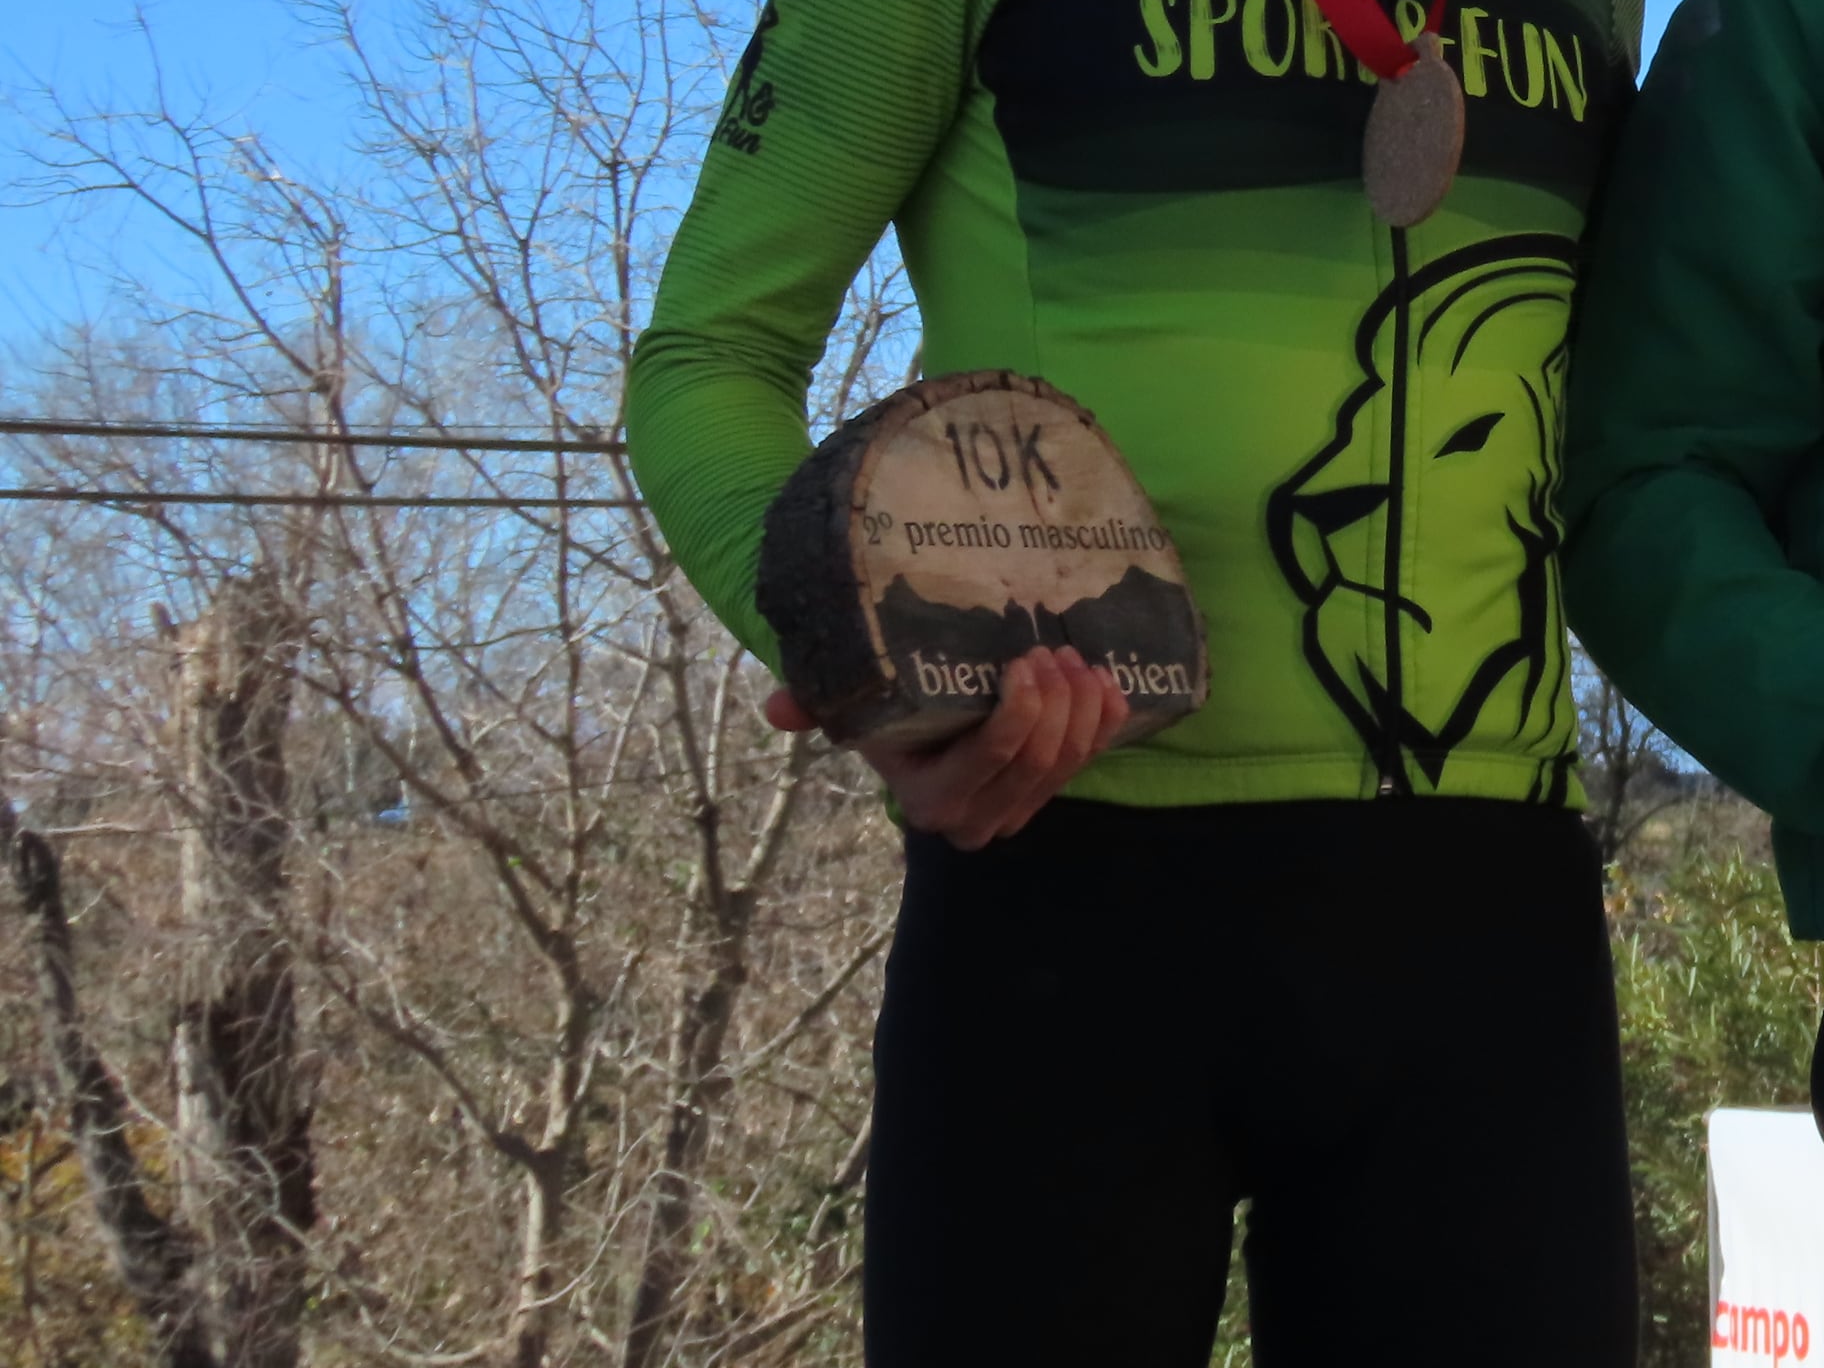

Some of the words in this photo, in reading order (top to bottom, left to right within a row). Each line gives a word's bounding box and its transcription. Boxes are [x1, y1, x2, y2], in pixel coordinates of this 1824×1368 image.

[944, 422, 1061, 492] 10K
[904, 517, 1011, 554] premio
[1018, 518, 1170, 551] masculino
